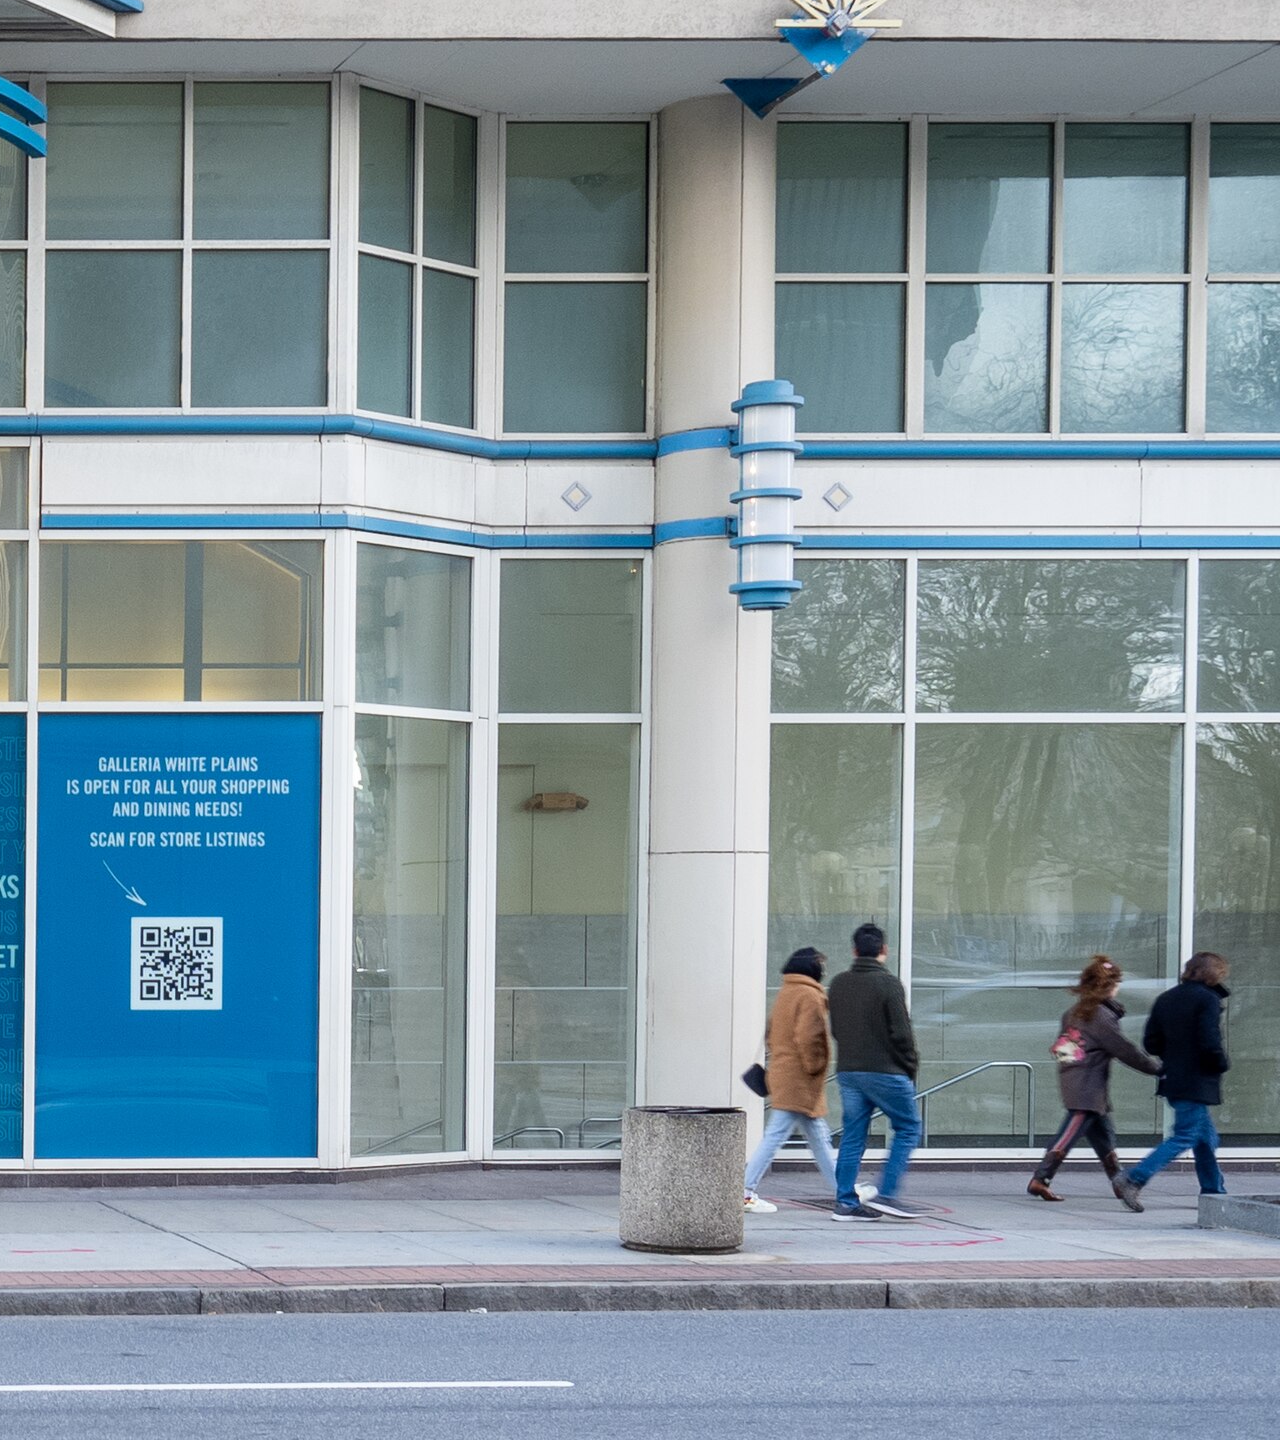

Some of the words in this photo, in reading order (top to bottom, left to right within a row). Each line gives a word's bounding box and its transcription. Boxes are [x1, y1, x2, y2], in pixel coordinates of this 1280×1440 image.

[98, 757, 161, 772] GALLERIA
[165, 757, 207, 772] WHITE
[211, 756, 258, 772] PLAINS
[67, 779, 80, 795] IS
[84, 779, 119, 795] OPEN
[124, 779, 150, 795] FOR
[154, 779, 177, 794] ALL
[181, 779, 217, 794] YOUR
[221, 779, 289, 794] SHOPPING
[112, 802, 139, 817] AND
[144, 802, 190, 817] DINING
[195, 801, 243, 817] NEEDS!
[90, 832, 125, 847] SCAN
[129, 832, 155, 847] FOR
[160, 831, 201, 847] STORE
[206, 831, 265, 847] LISTINGS
